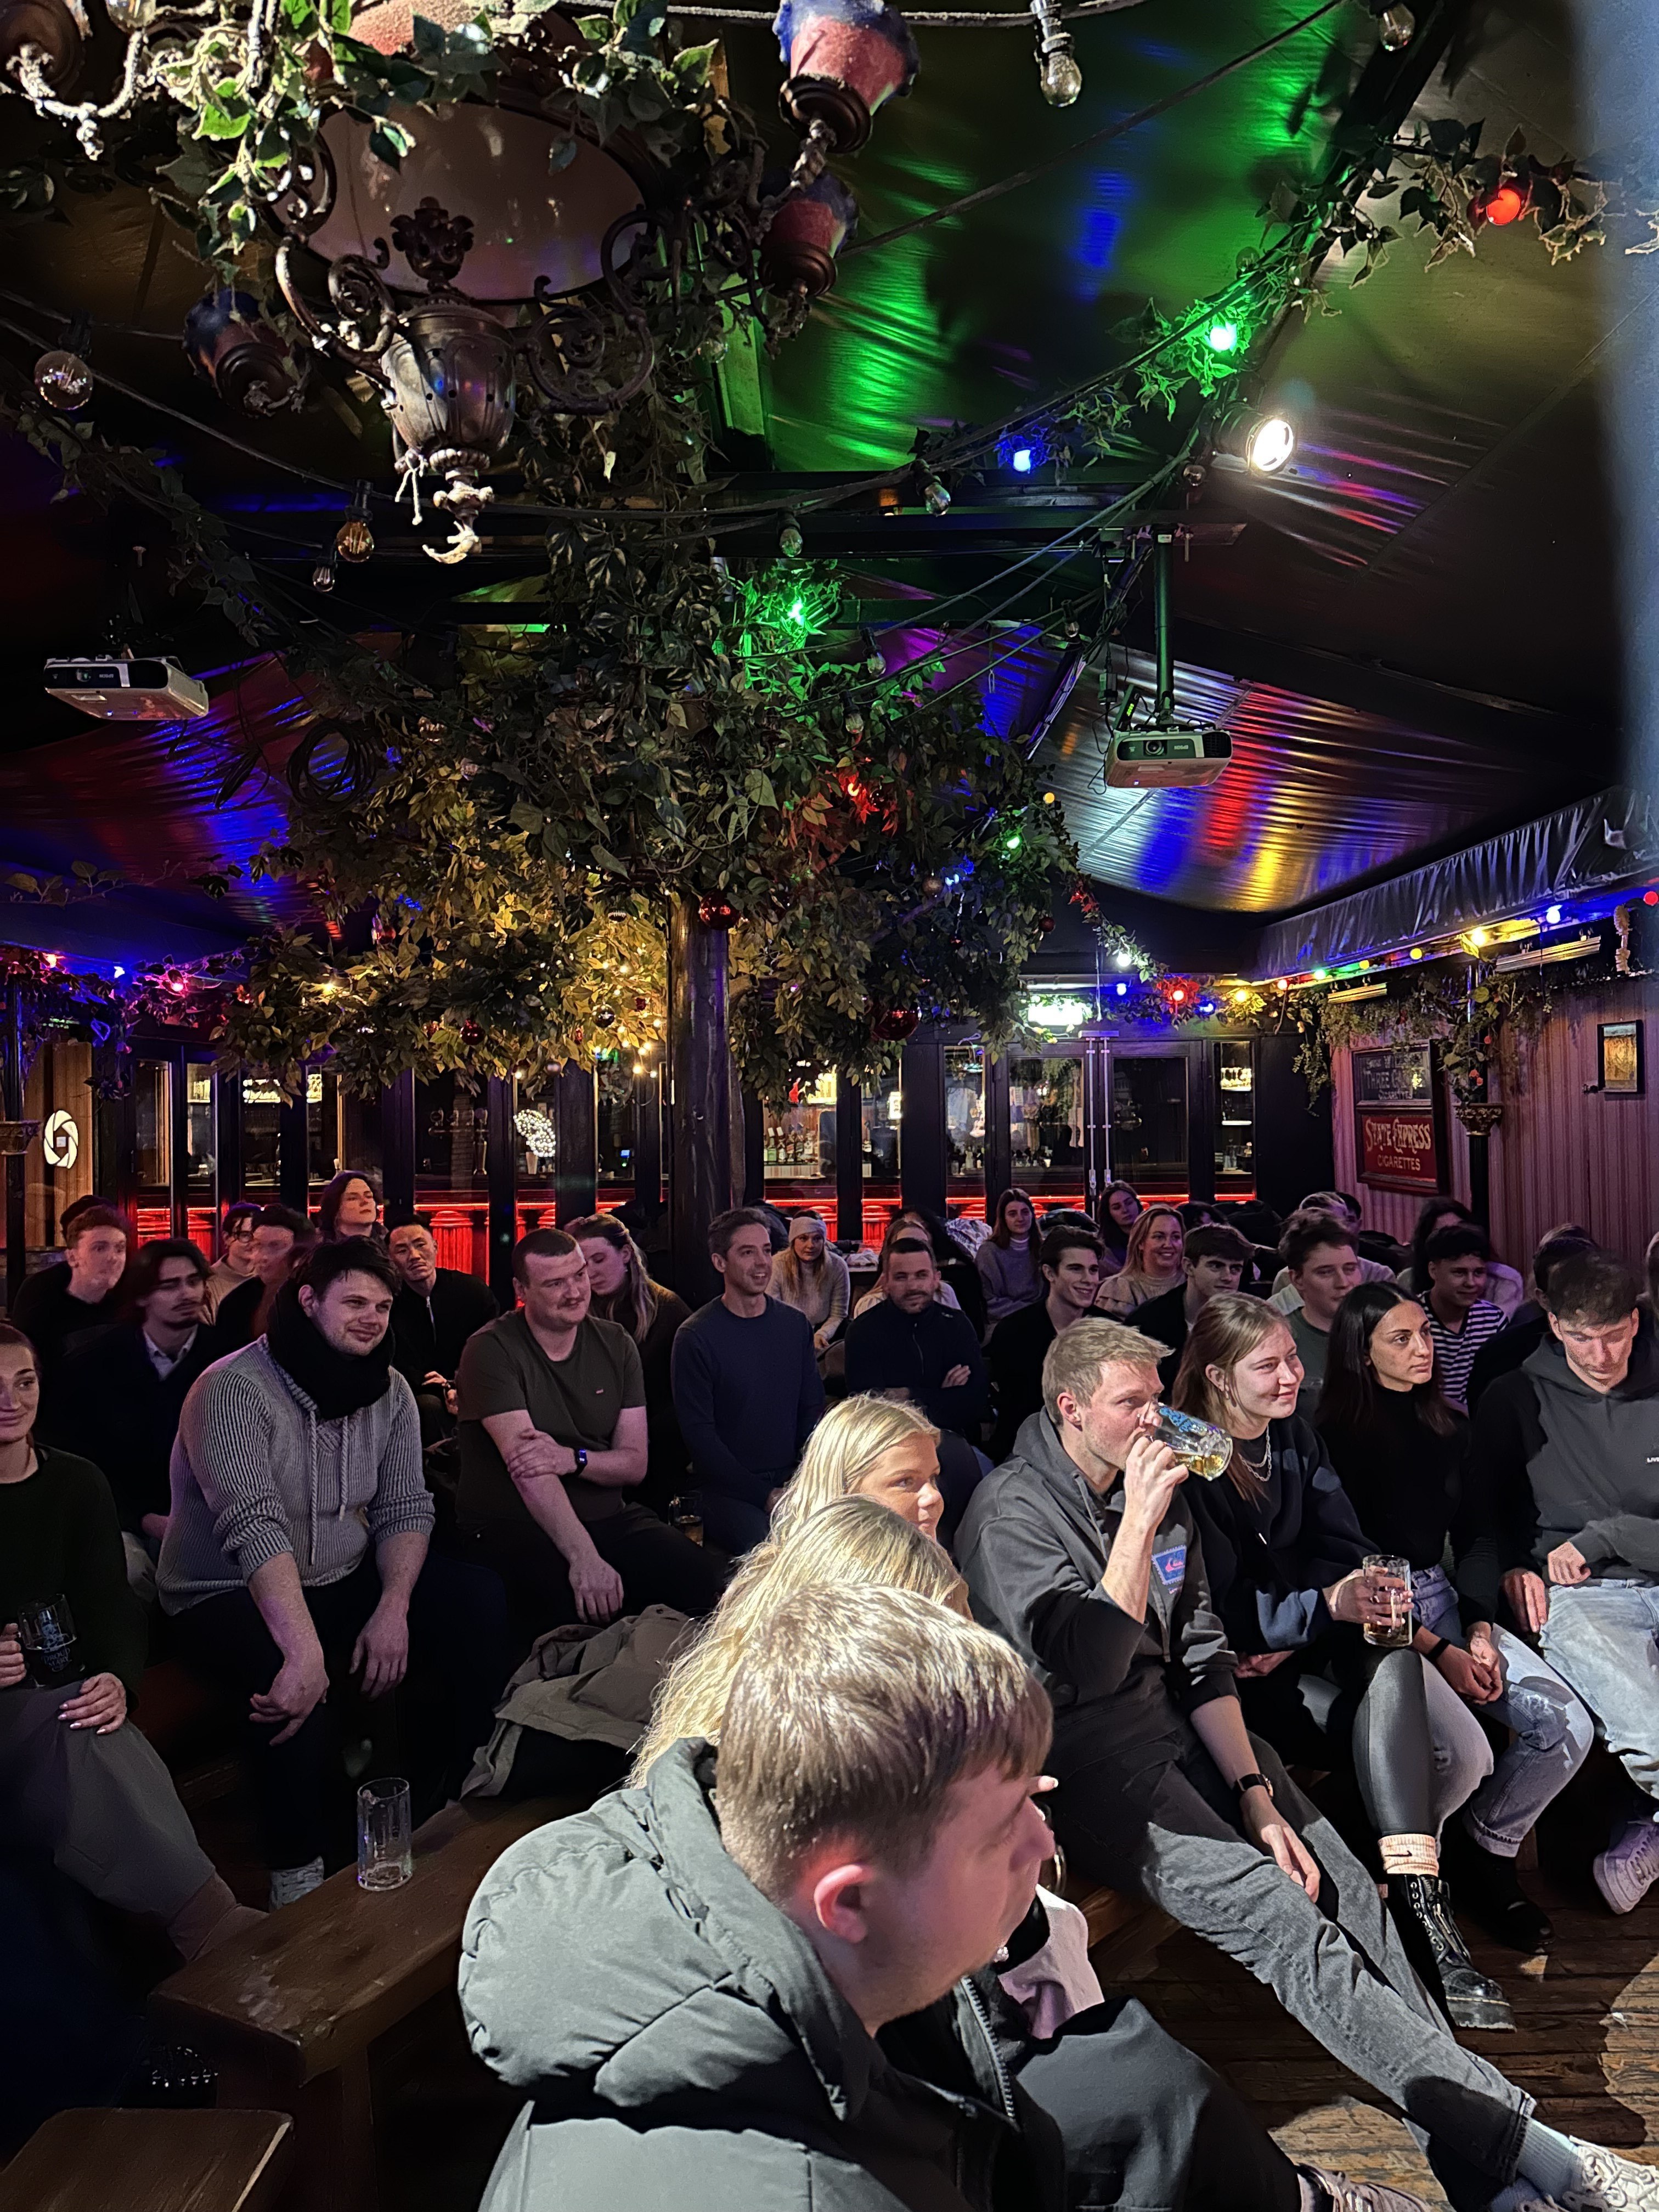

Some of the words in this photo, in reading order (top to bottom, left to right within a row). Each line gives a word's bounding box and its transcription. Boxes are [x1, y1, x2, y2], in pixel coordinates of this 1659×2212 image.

[1365, 1118, 1392, 1152] STATE
[1392, 1116, 1431, 1154] EXPRESS
[1377, 1154, 1420, 1171] CIGARETTES
